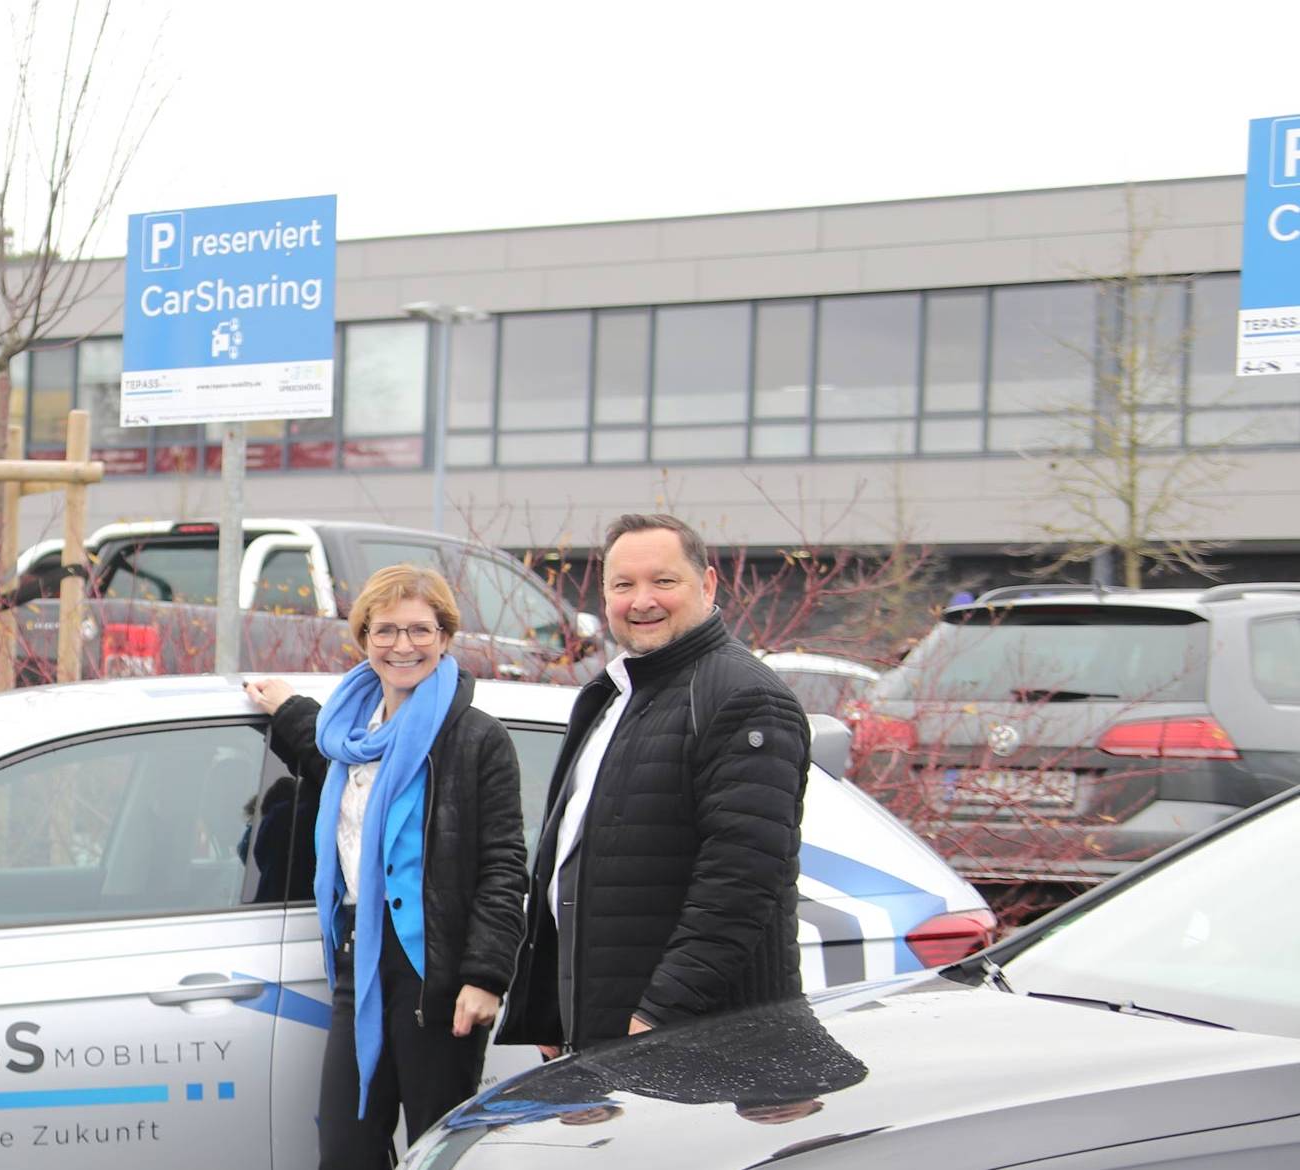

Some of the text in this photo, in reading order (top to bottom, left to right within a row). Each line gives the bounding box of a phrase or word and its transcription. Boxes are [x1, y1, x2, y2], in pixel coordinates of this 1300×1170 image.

[151, 219, 322, 264] P reserviert
[140, 274, 322, 318] CarSharing
[55, 1040, 232, 1068] MOBILITY
[32, 1120, 160, 1147] Zukunft
